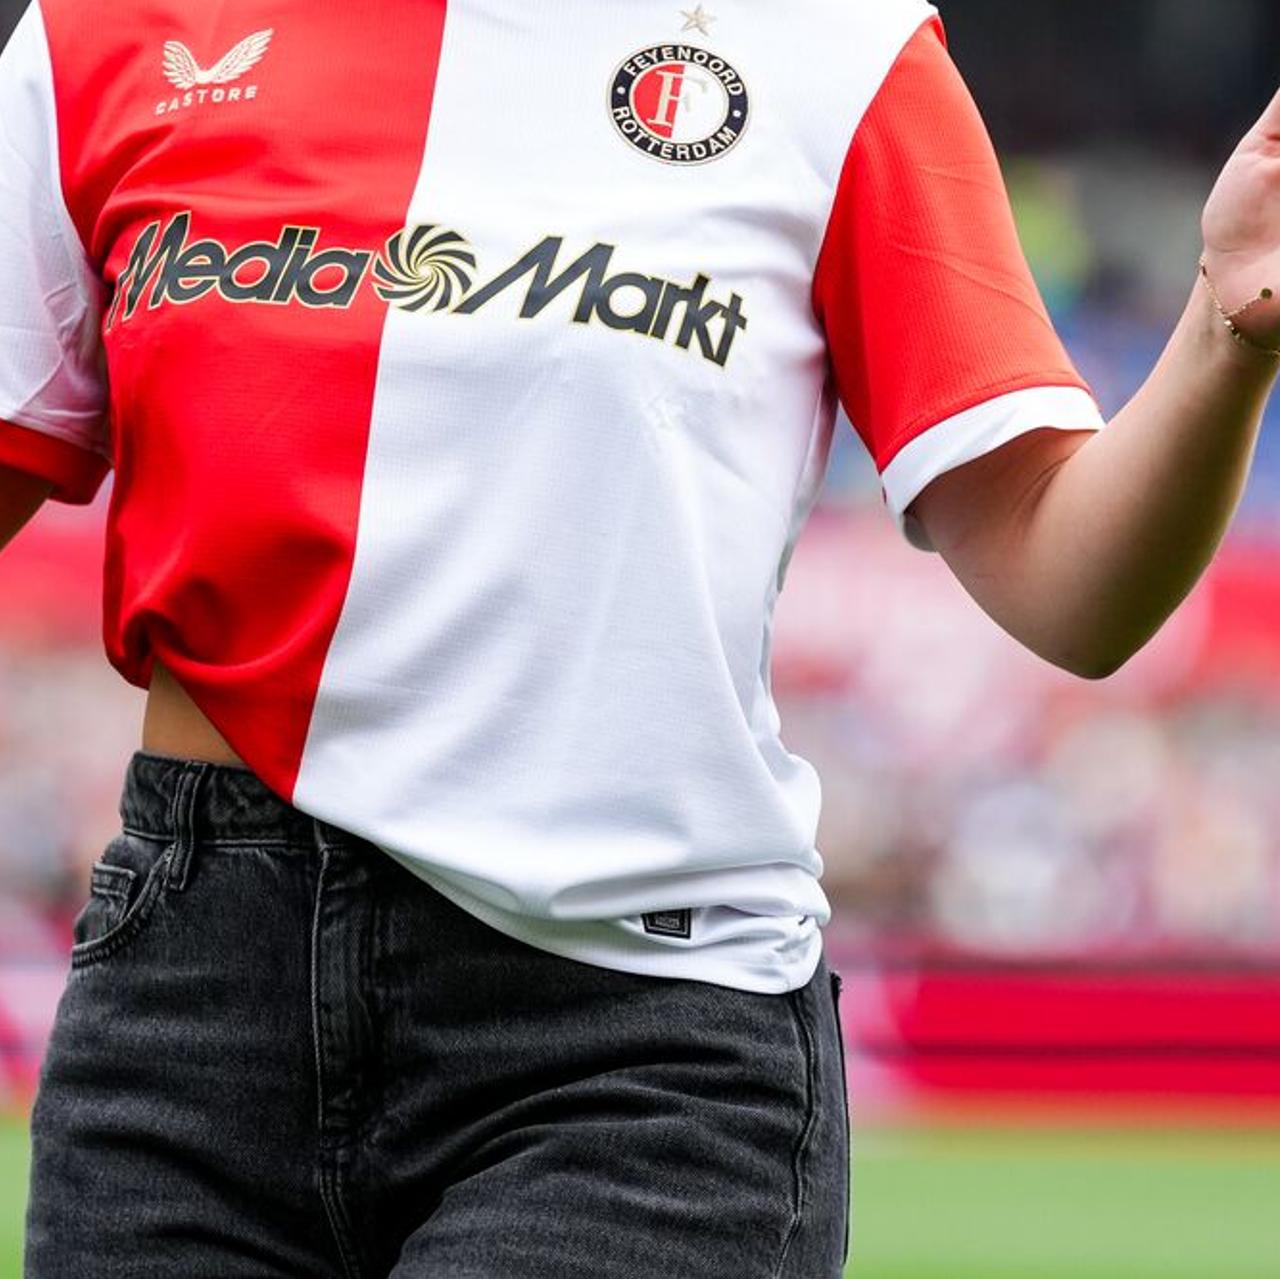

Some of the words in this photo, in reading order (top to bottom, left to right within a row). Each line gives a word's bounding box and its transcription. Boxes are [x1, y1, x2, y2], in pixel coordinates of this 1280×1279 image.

[624, 46, 743, 96] FEYENOORD
[155, 85, 258, 115] CASTORE
[613, 106, 737, 160] ROTTERDAM
[103, 209, 374, 333] Media
[451, 235, 748, 367] Markt
